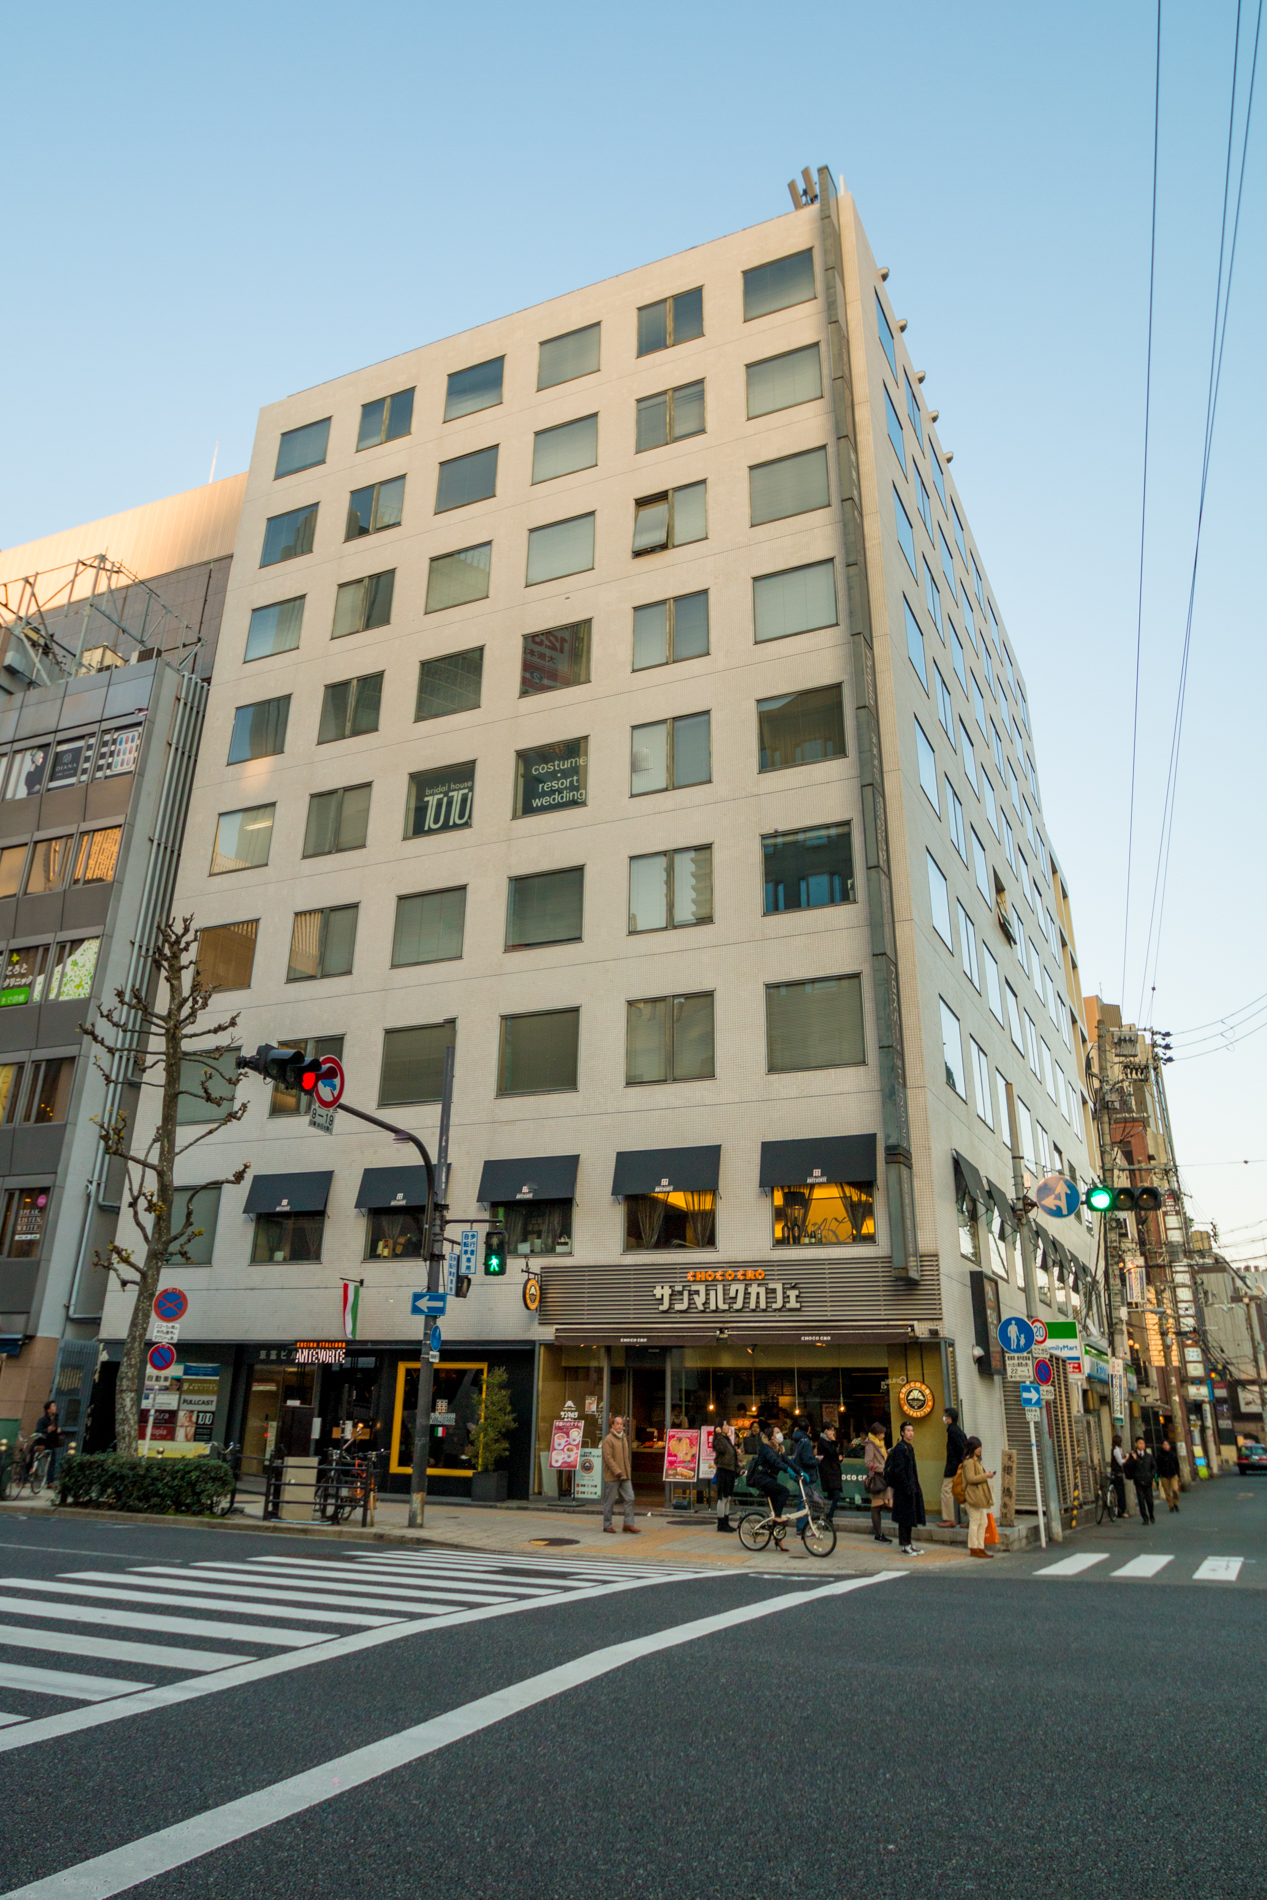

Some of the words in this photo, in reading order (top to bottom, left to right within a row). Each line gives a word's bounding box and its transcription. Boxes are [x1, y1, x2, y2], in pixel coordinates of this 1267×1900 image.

[56, 762, 77, 772] DIANA
[532, 755, 588, 775] costume
[425, 783, 448, 795] bridal
[450, 780, 473, 790] house
[539, 775, 579, 792] resort
[531, 789, 586, 808] wedding
[686, 1270, 735, 1282] CHOCO
[736, 1269, 766, 1281] CRO
[653, 1282, 801, 1312] サンマルクカフェ
[1033, 1325, 1045, 1338] 20
